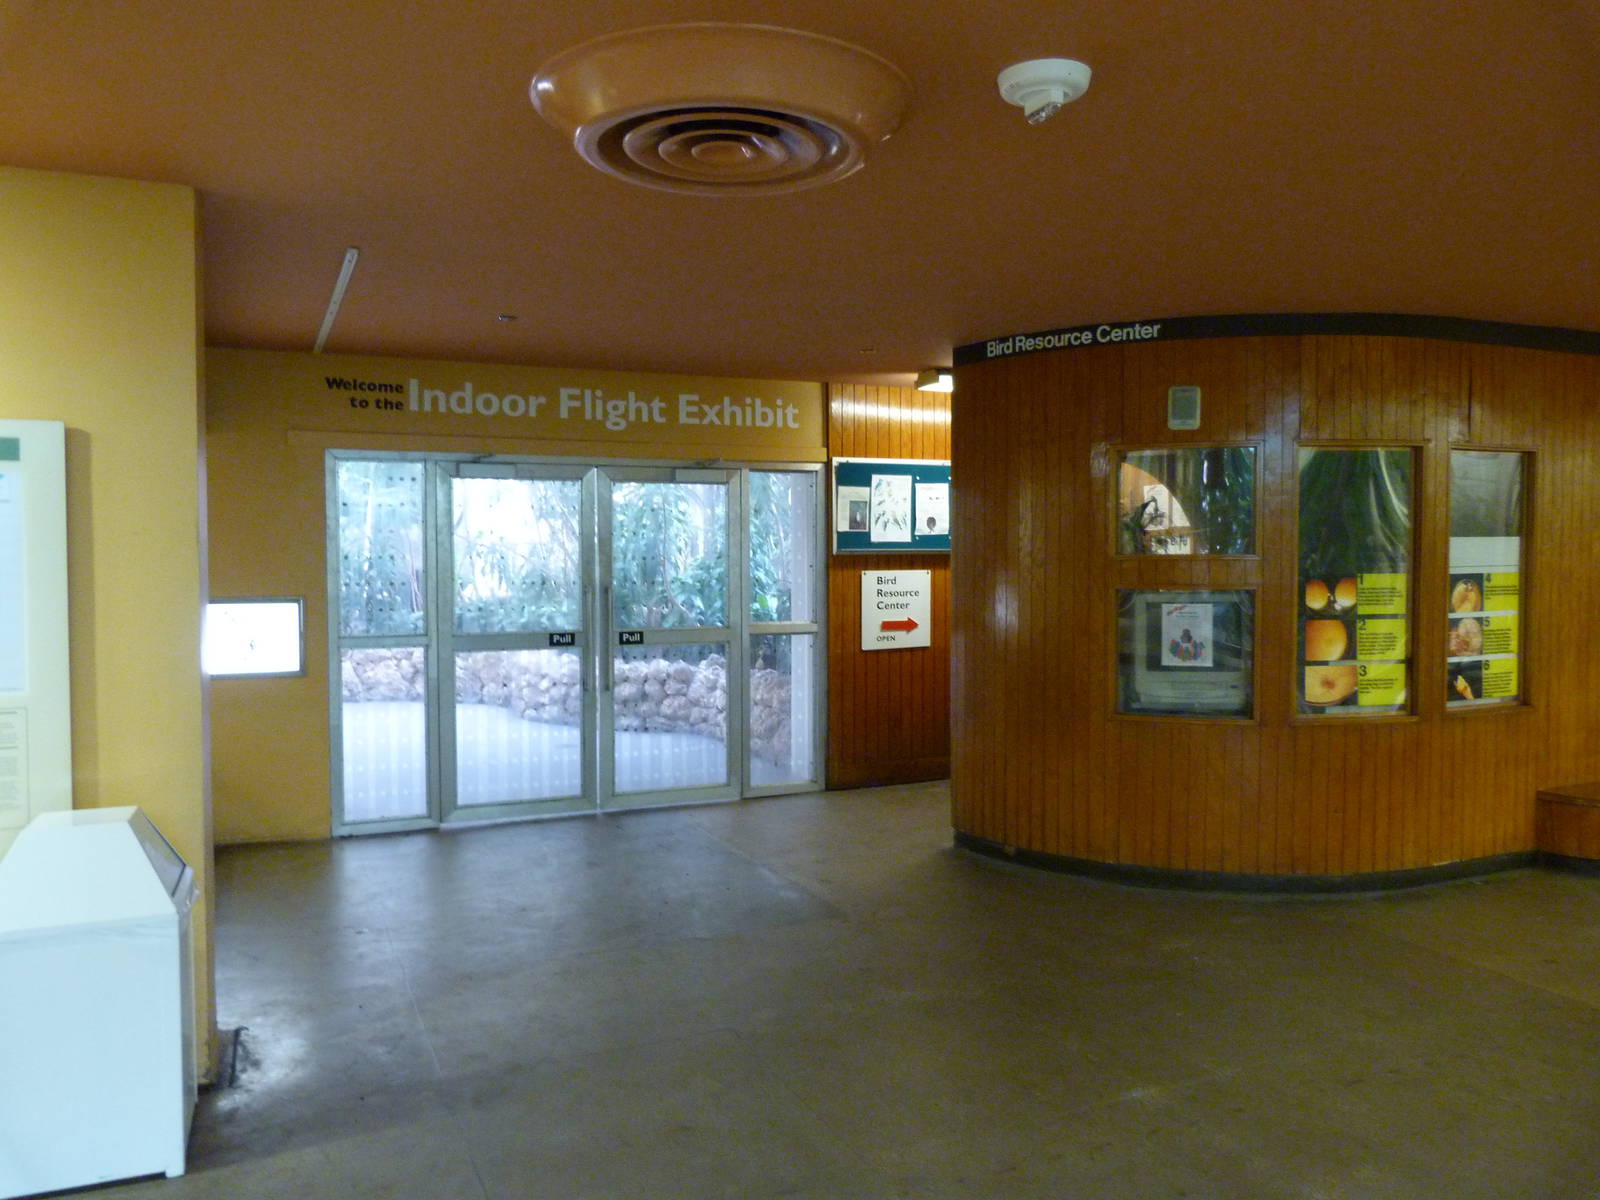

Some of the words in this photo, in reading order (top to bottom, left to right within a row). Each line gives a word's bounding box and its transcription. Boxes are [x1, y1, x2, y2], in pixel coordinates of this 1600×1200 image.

[987, 340, 1013, 357] Bird
[1015, 331, 1093, 352] Resource
[1096, 324, 1161, 343] Center
[325, 377, 404, 395] Welcome
[350, 396, 369, 410] to
[375, 396, 404, 411] the
[408, 379, 546, 418] Indoor
[559, 387, 667, 431] Flight
[678, 394, 800, 430] Exhibit
[876, 576, 896, 585] Bird
[876, 589, 920, 598] Resource
[876, 601, 910, 610] Center
[1359, 619, 1366, 630] 2
[553, 634, 572, 643] Pull
[623, 633, 640, 642] Pull
[1359, 665, 1367, 676] 3
